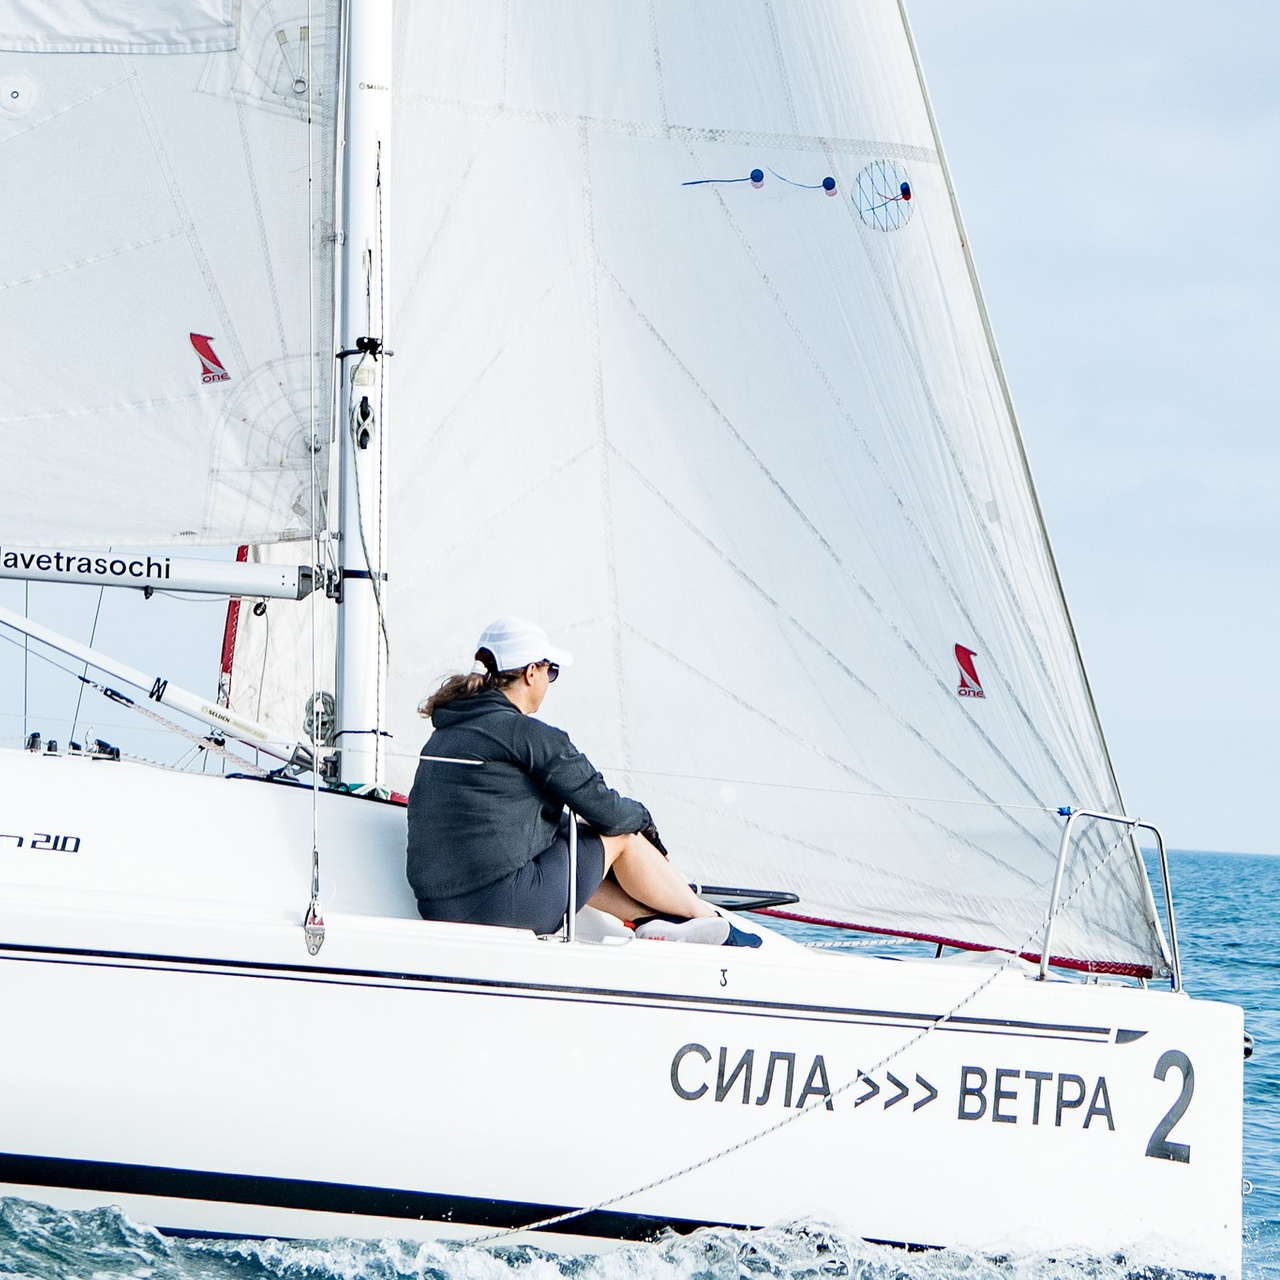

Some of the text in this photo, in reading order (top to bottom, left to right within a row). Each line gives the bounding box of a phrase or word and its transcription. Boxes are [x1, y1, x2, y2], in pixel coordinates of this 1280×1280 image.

[31, 833, 81, 853] 210
[671, 1043, 1115, 1131] СИЛА ВЕТРА
[1145, 1050, 1195, 1164] 2
